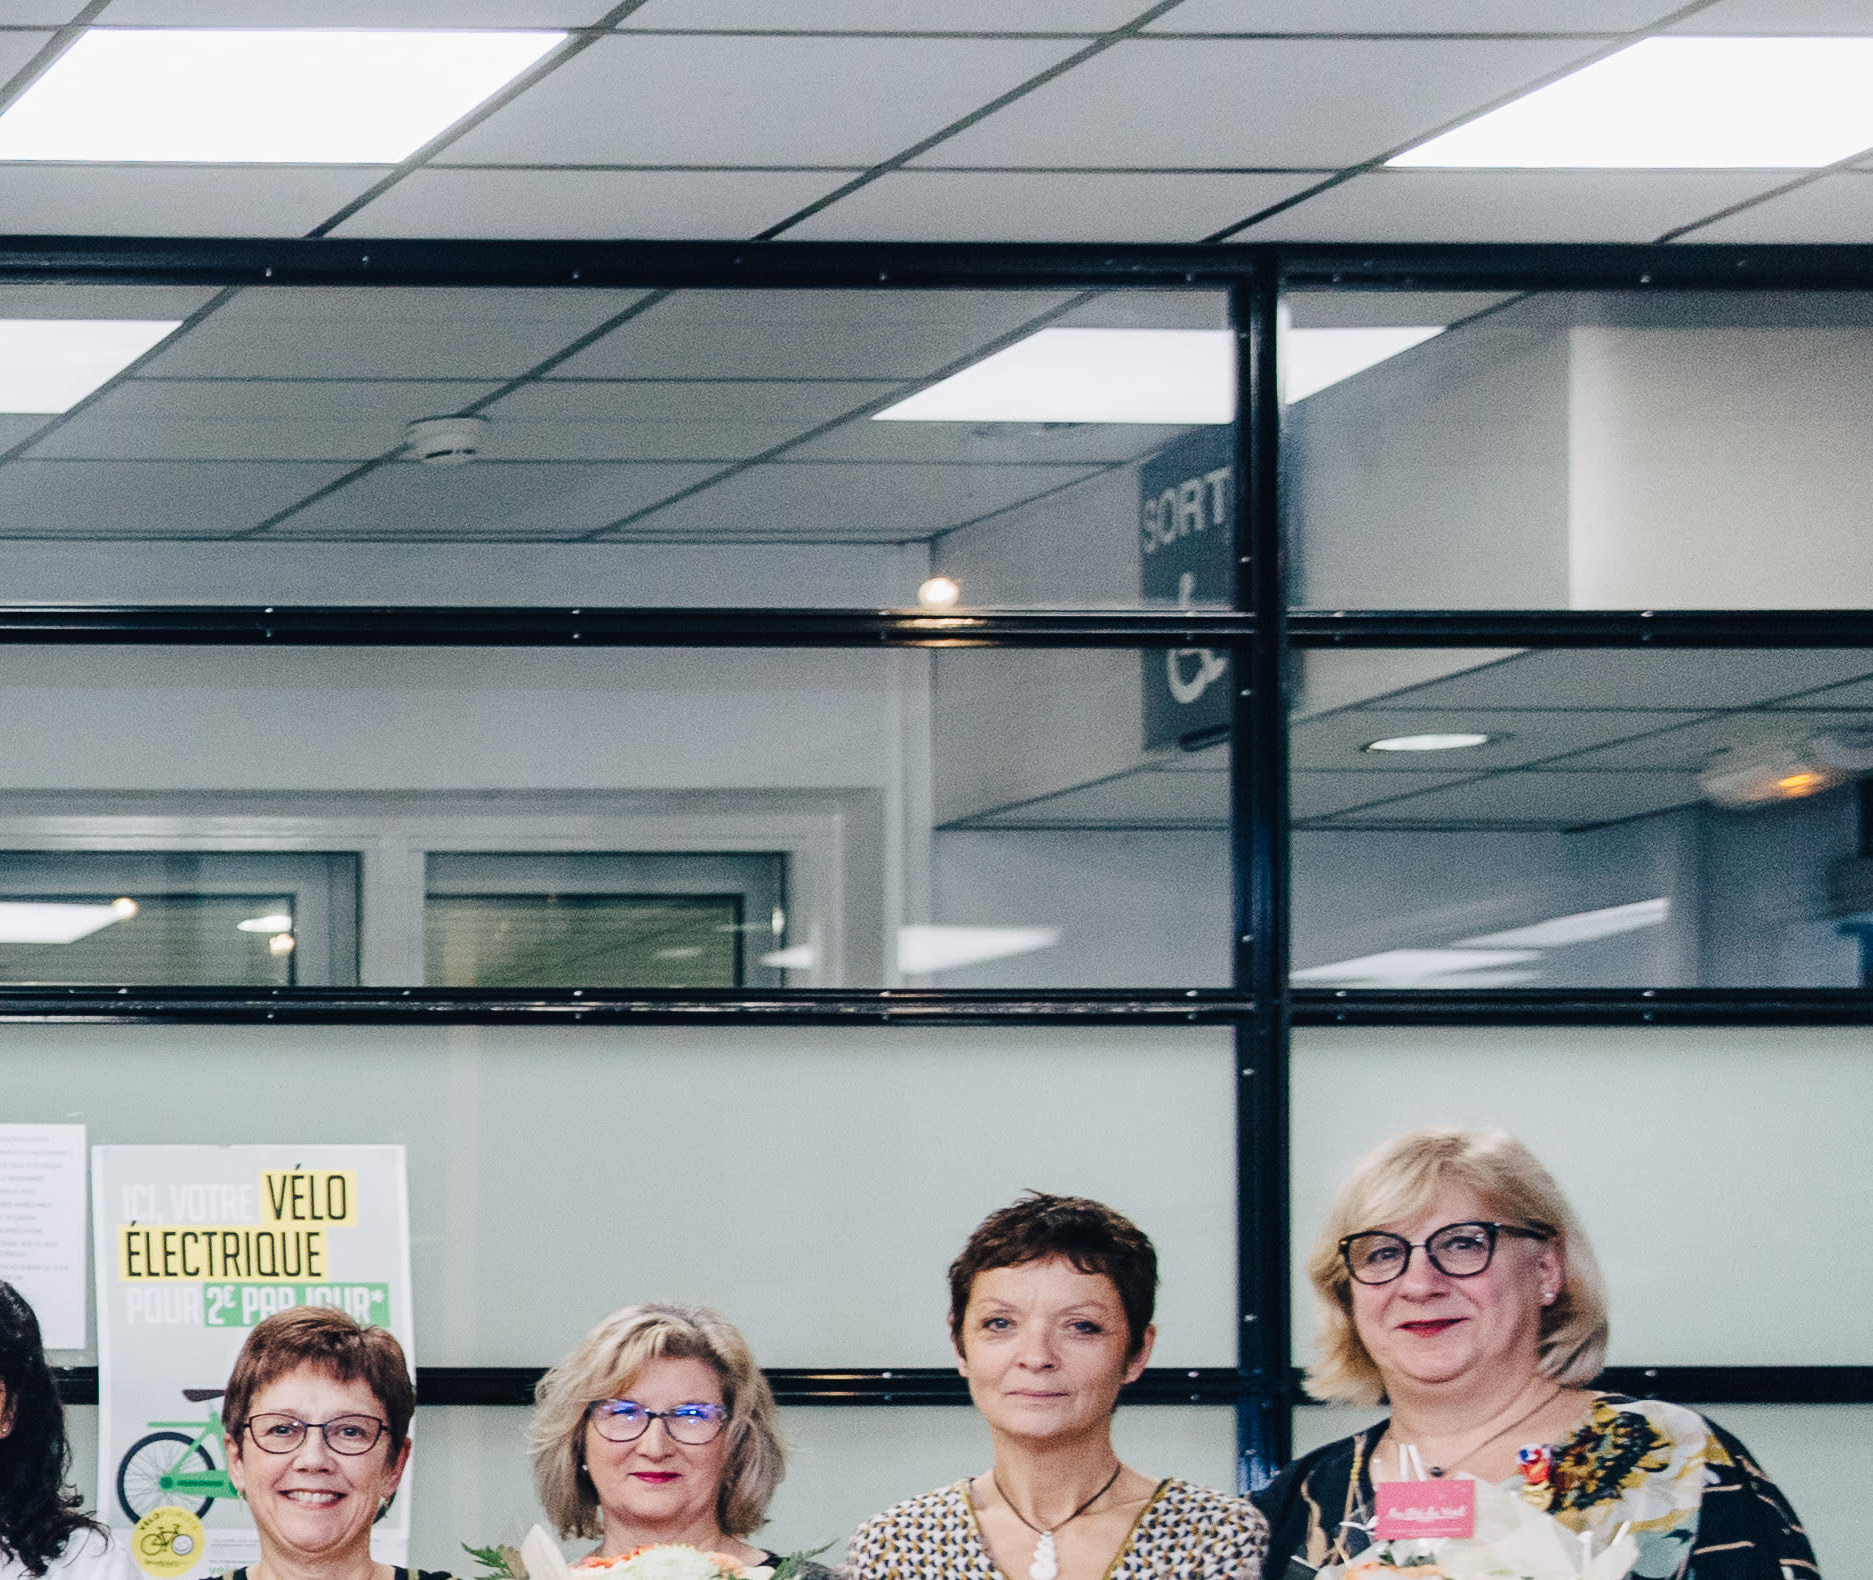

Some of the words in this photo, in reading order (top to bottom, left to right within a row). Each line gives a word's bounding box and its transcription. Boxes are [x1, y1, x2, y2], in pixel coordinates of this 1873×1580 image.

[1143, 465, 1233, 554] SORT
[168, 1184, 254, 1222] VOTRE
[266, 1163, 347, 1221] VÉLO
[125, 1220, 323, 1278] ÉLECTRIQUE
[126, 1286, 202, 1325] POUR
